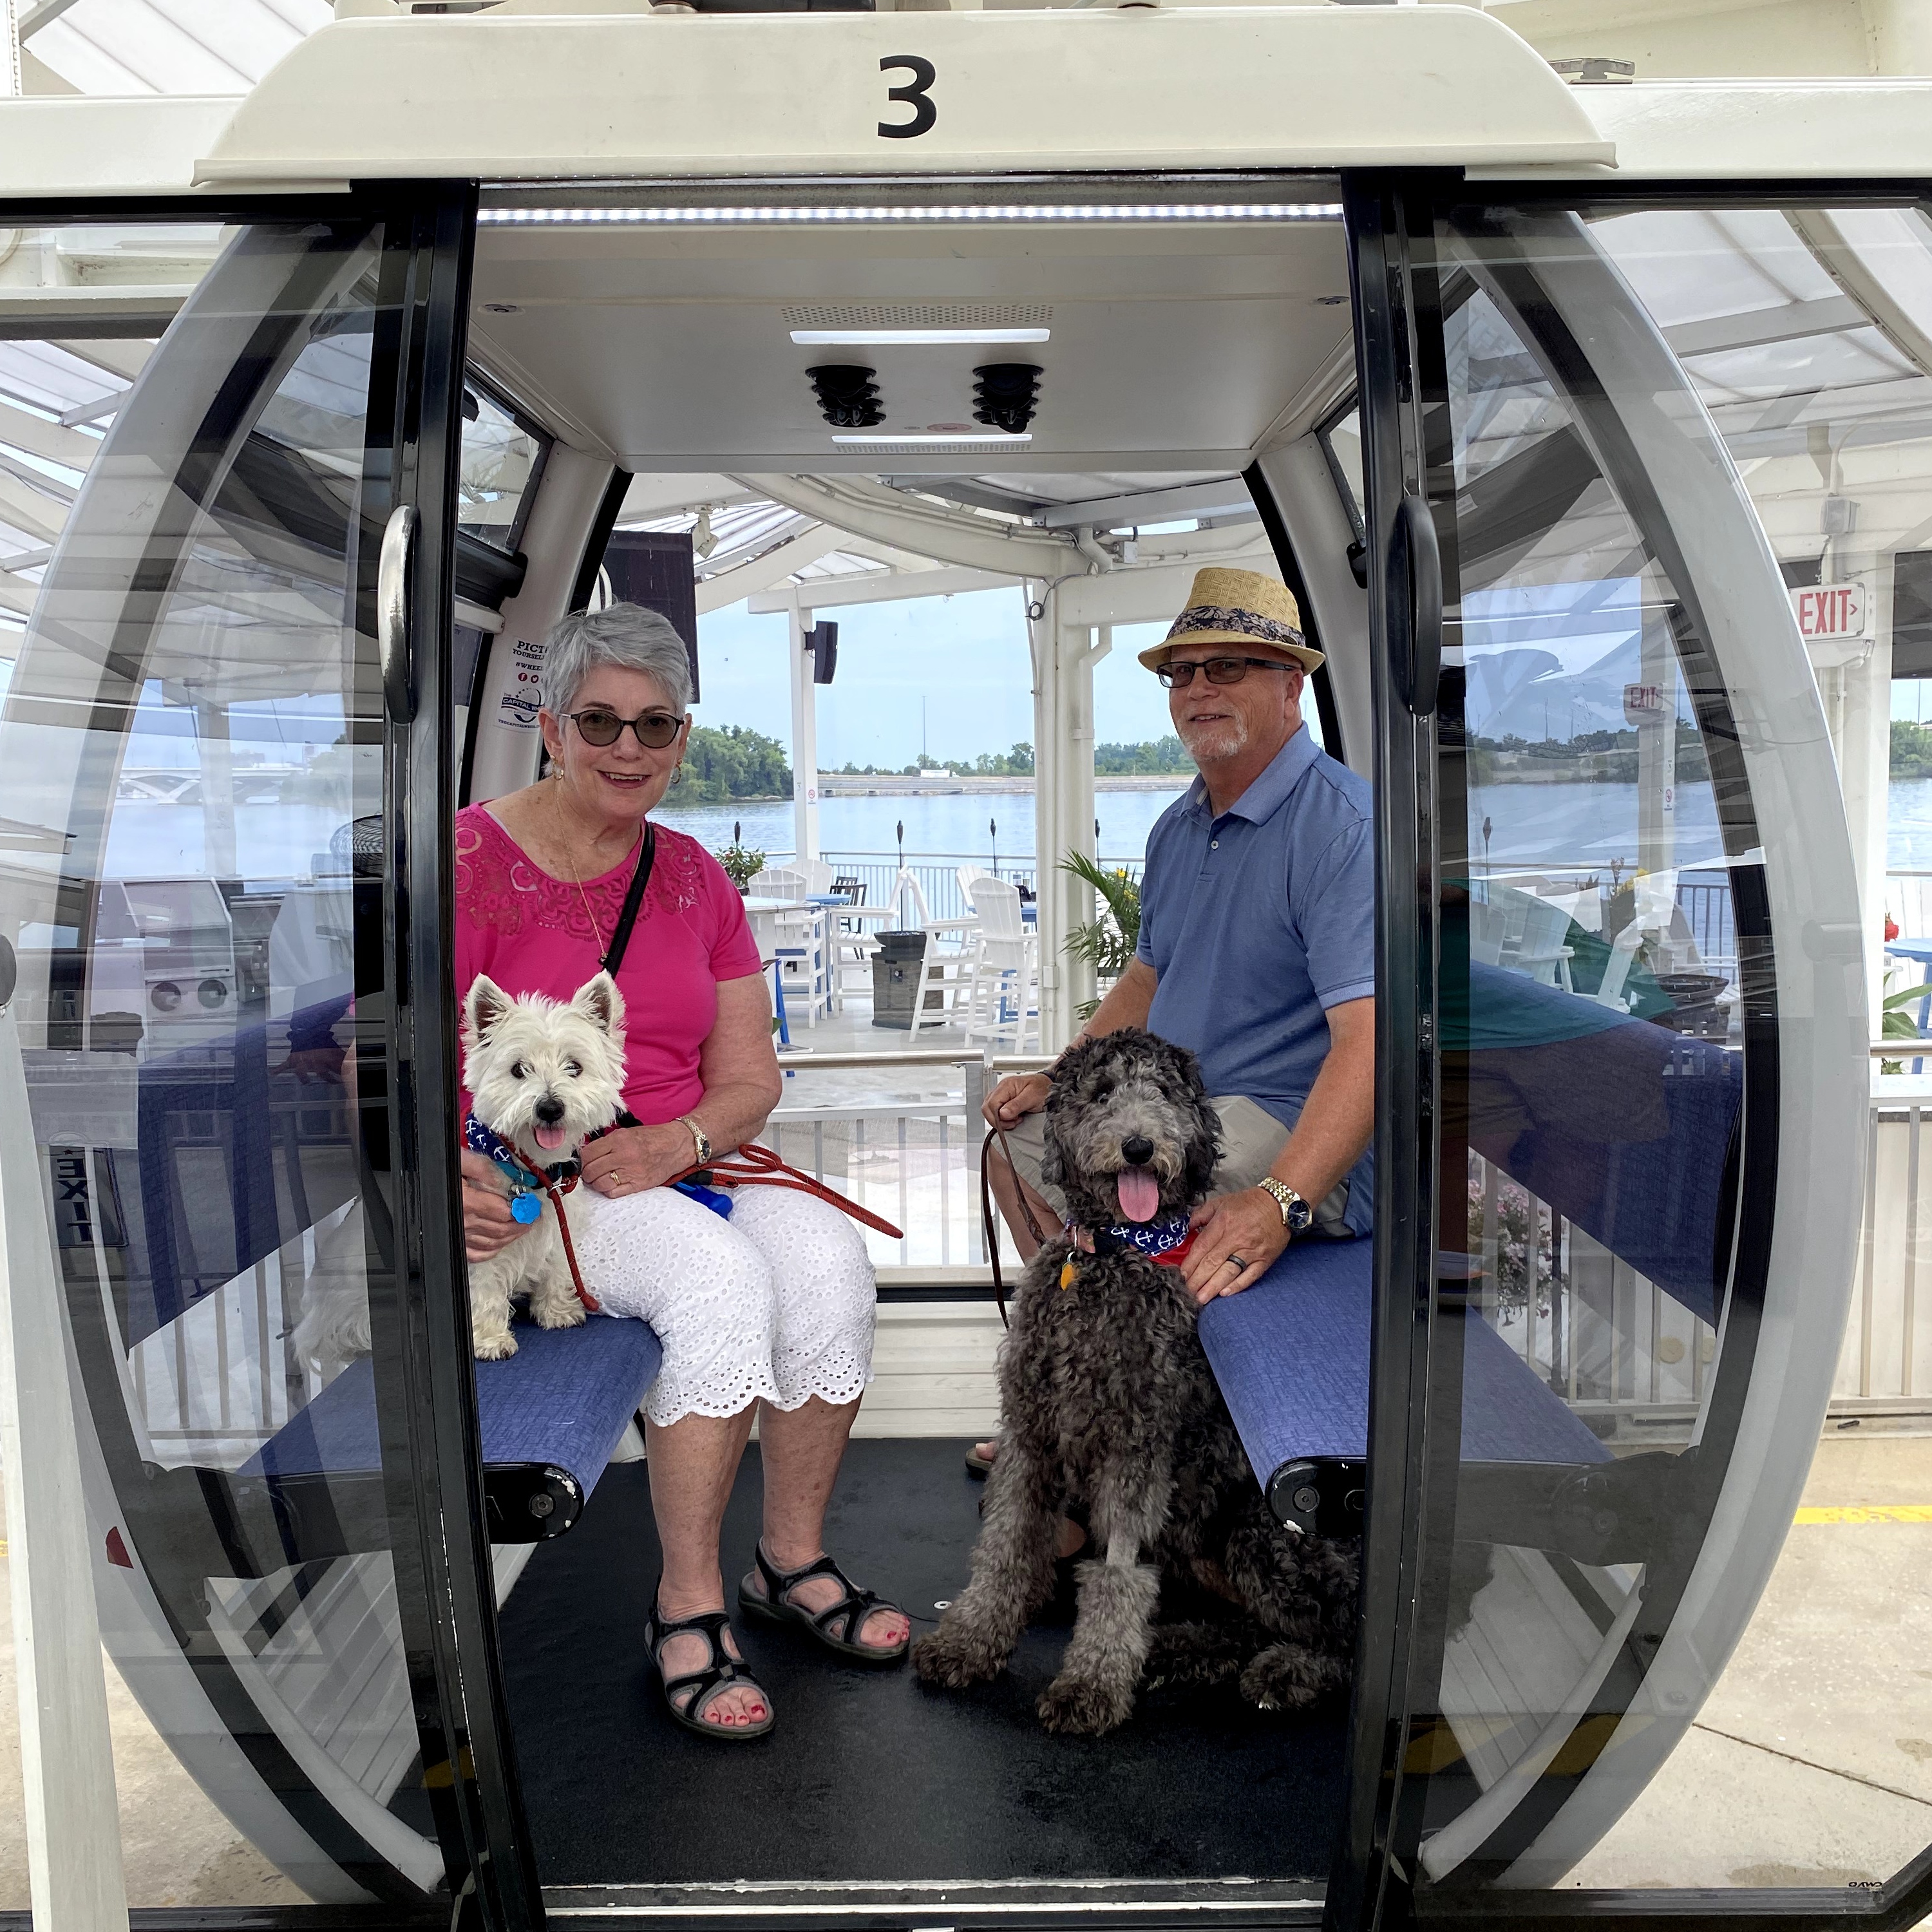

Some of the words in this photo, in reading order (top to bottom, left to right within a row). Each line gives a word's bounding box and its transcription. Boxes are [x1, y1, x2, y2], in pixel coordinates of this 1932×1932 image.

[878, 55, 937, 139] 3
[1799, 589, 1852, 635] EXIT
[516, 640, 547, 654] PICT
[503, 698, 531, 709] CAPITAL
[1631, 687, 1656, 708] EXIT
